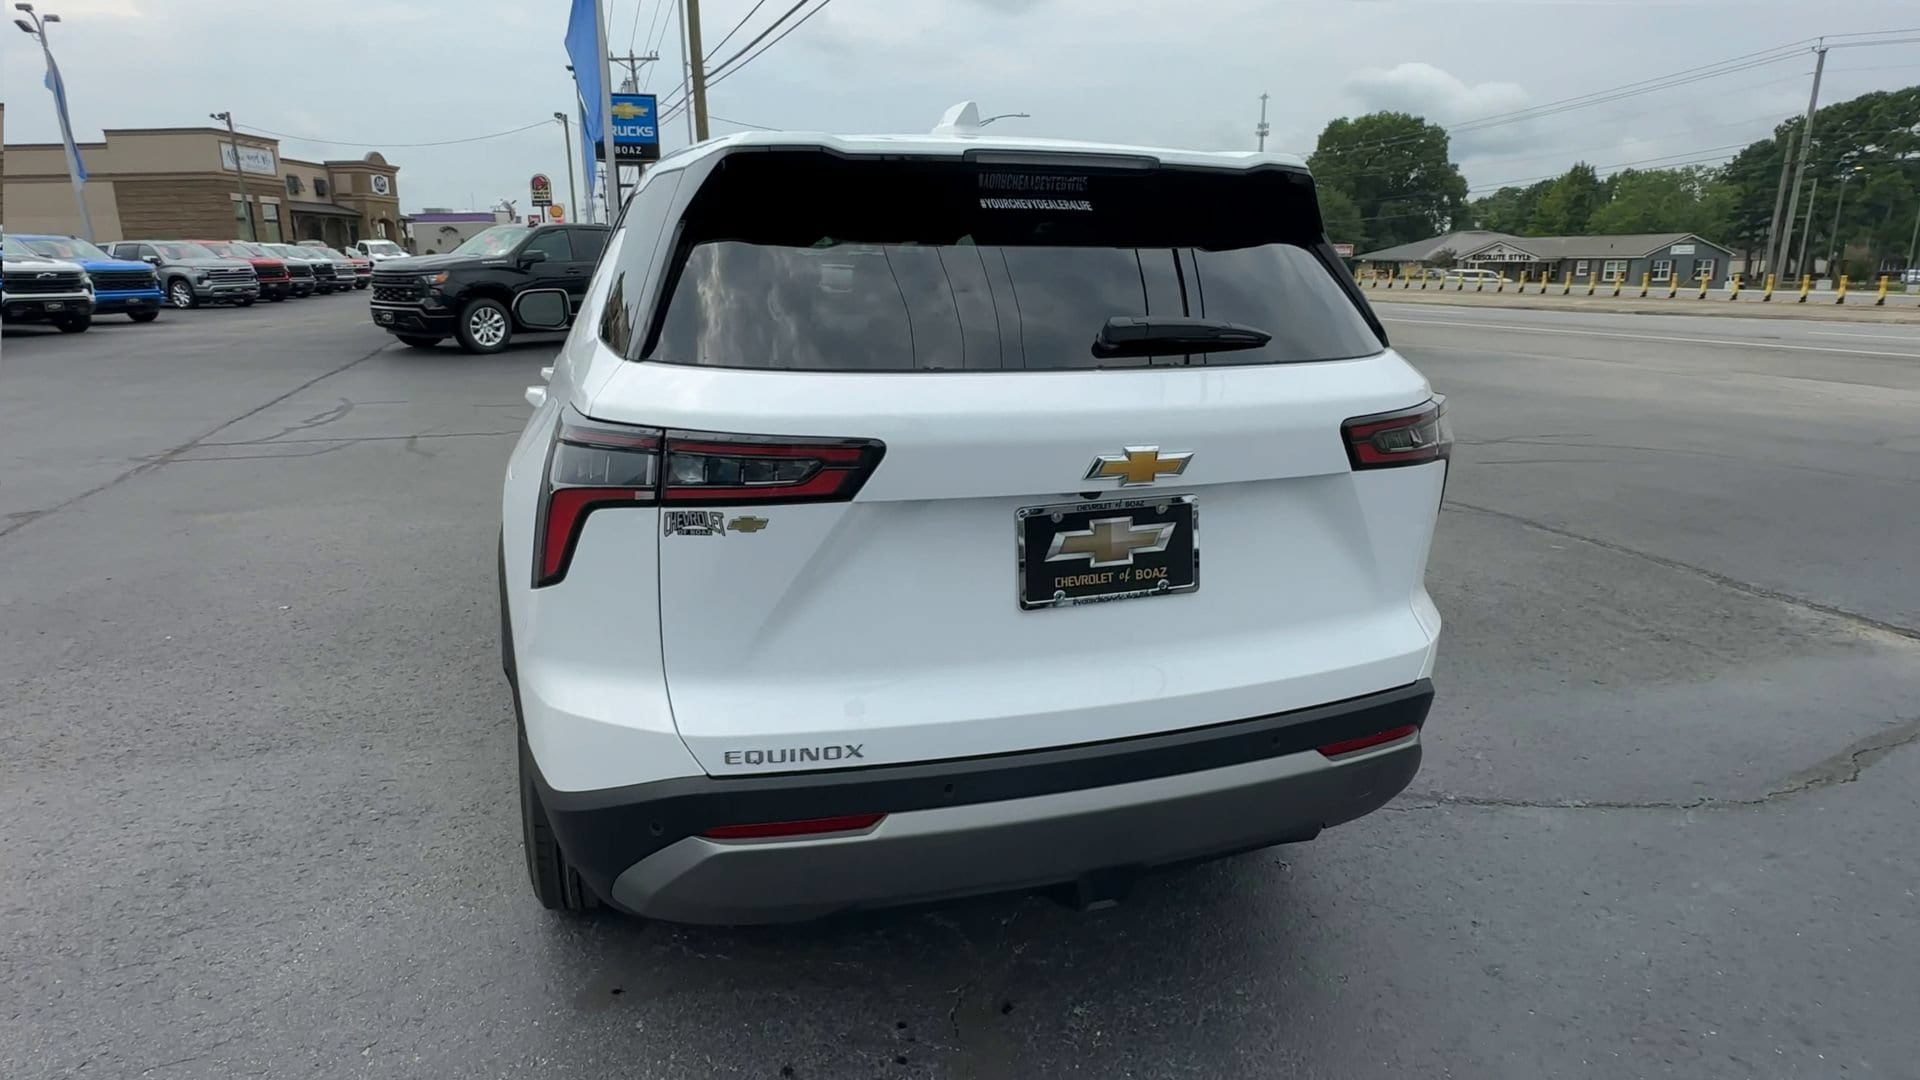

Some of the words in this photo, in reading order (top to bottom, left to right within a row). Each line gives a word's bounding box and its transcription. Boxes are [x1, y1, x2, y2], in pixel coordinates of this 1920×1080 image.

[612, 125, 654, 137] RUCKS
[615, 146, 642, 154] BOAZ
[1076, 502, 1112, 512] CHEVROLET
[1125, 500, 1145, 508] BOAZ
[664, 511, 726, 537] CHEVROLET
[1054, 572, 1114, 588] CHEVROLET
[1119, 567, 1131, 583] of
[1135, 567, 1168, 581] BOAZ
[724, 743, 864, 765] EQUINOX
